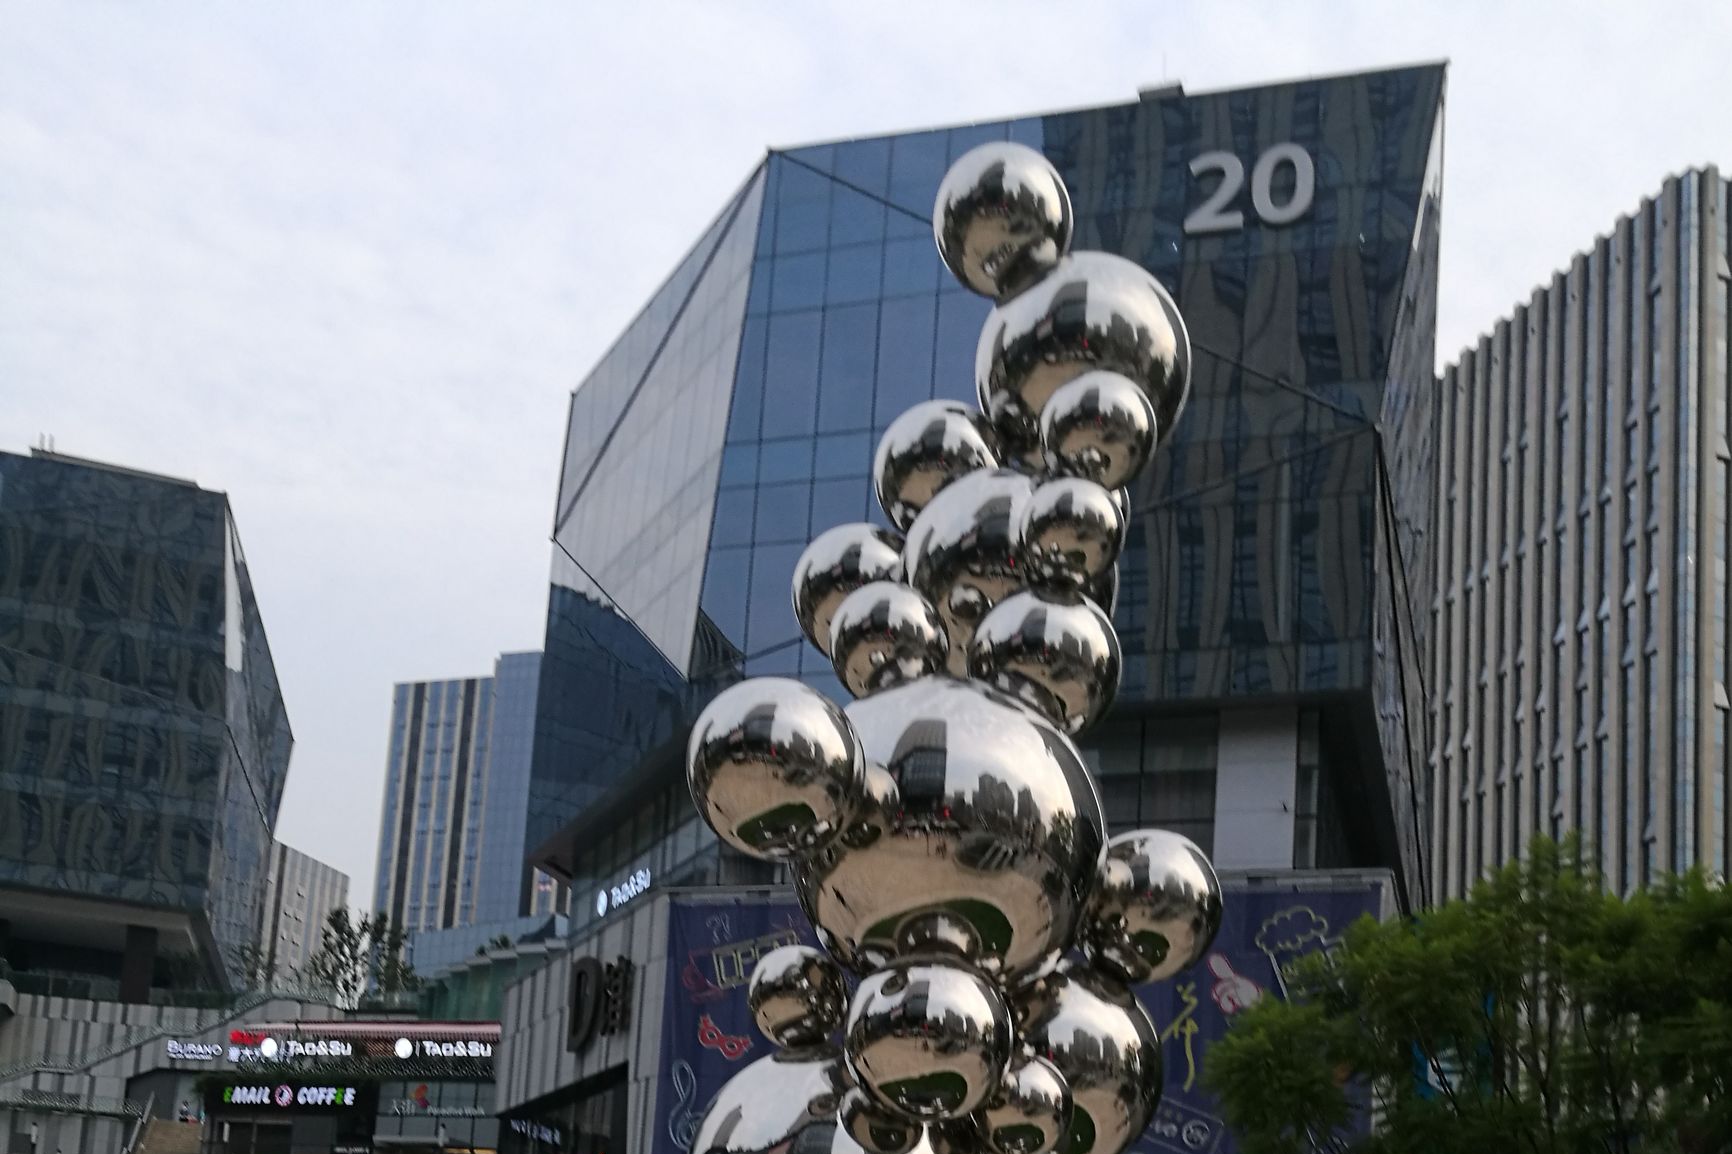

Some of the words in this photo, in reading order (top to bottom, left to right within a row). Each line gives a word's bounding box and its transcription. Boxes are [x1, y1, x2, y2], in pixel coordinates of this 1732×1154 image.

[1184, 142, 1316, 235] 20
[223, 1085, 271, 1105] EMAIL
[297, 1086, 356, 1106] COFFEE
